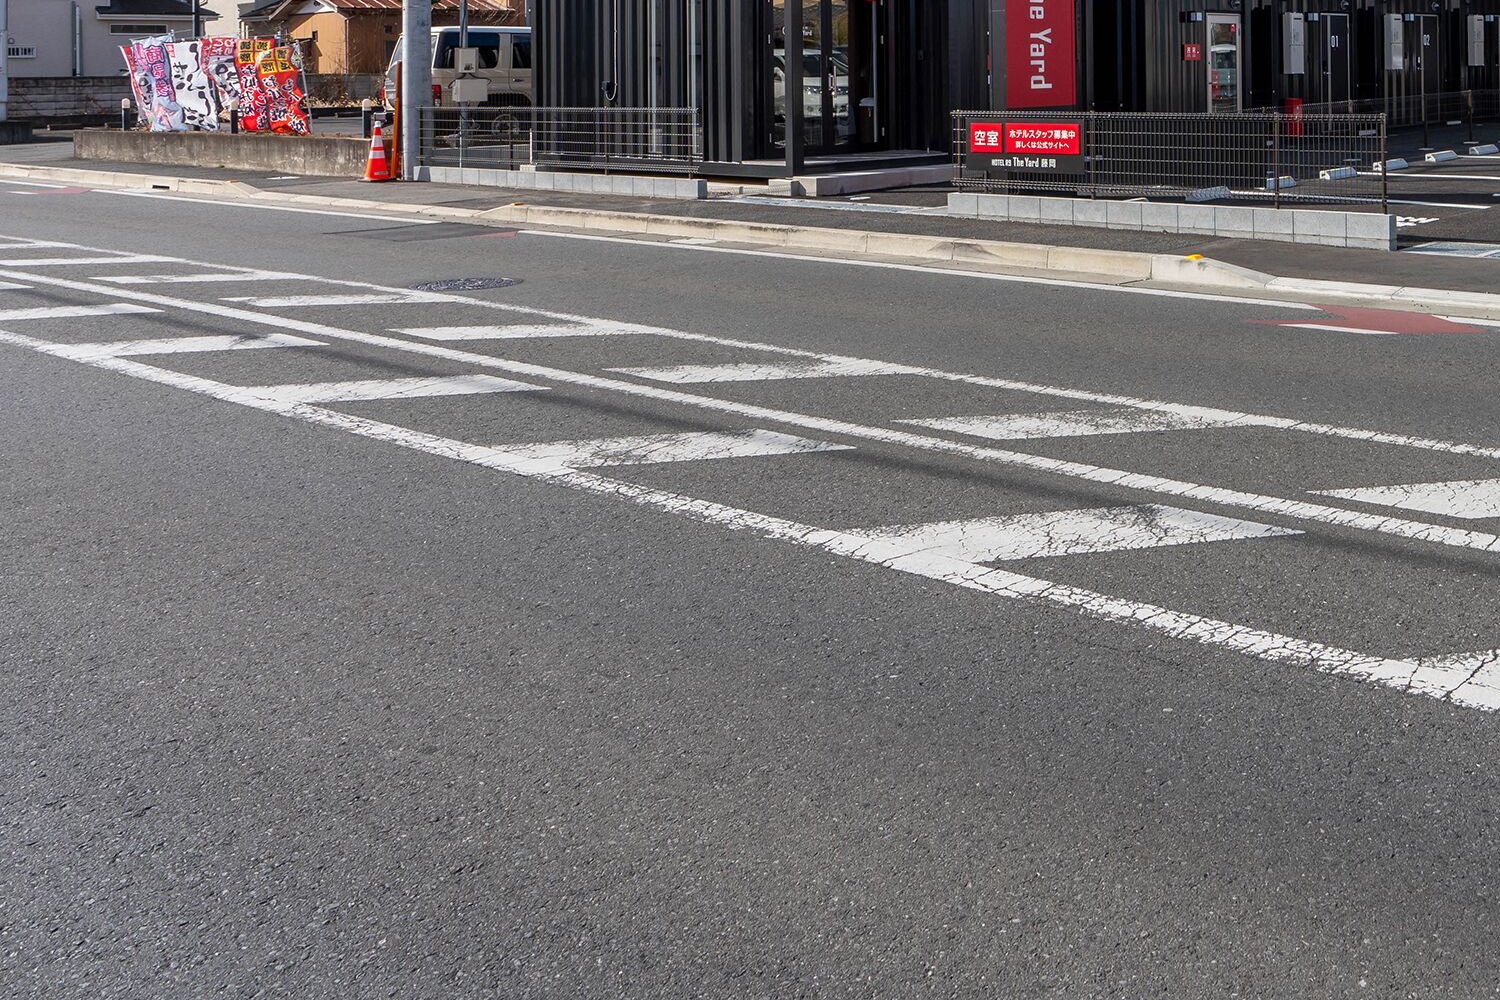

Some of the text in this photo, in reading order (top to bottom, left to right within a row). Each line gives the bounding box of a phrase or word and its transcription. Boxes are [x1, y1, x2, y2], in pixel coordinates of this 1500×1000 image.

[1331, 35, 1339, 48] 01
[1030, 28, 1052, 90] Yard
[974, 130, 999, 146] 空室
[1009, 129, 1076, 139] ホテルスタッフ募集中
[1015, 141, 1070, 149] 詳しくは公式サイトへ
[1013, 157, 1024, 167] The
[1025, 158, 1039, 168] Yard
